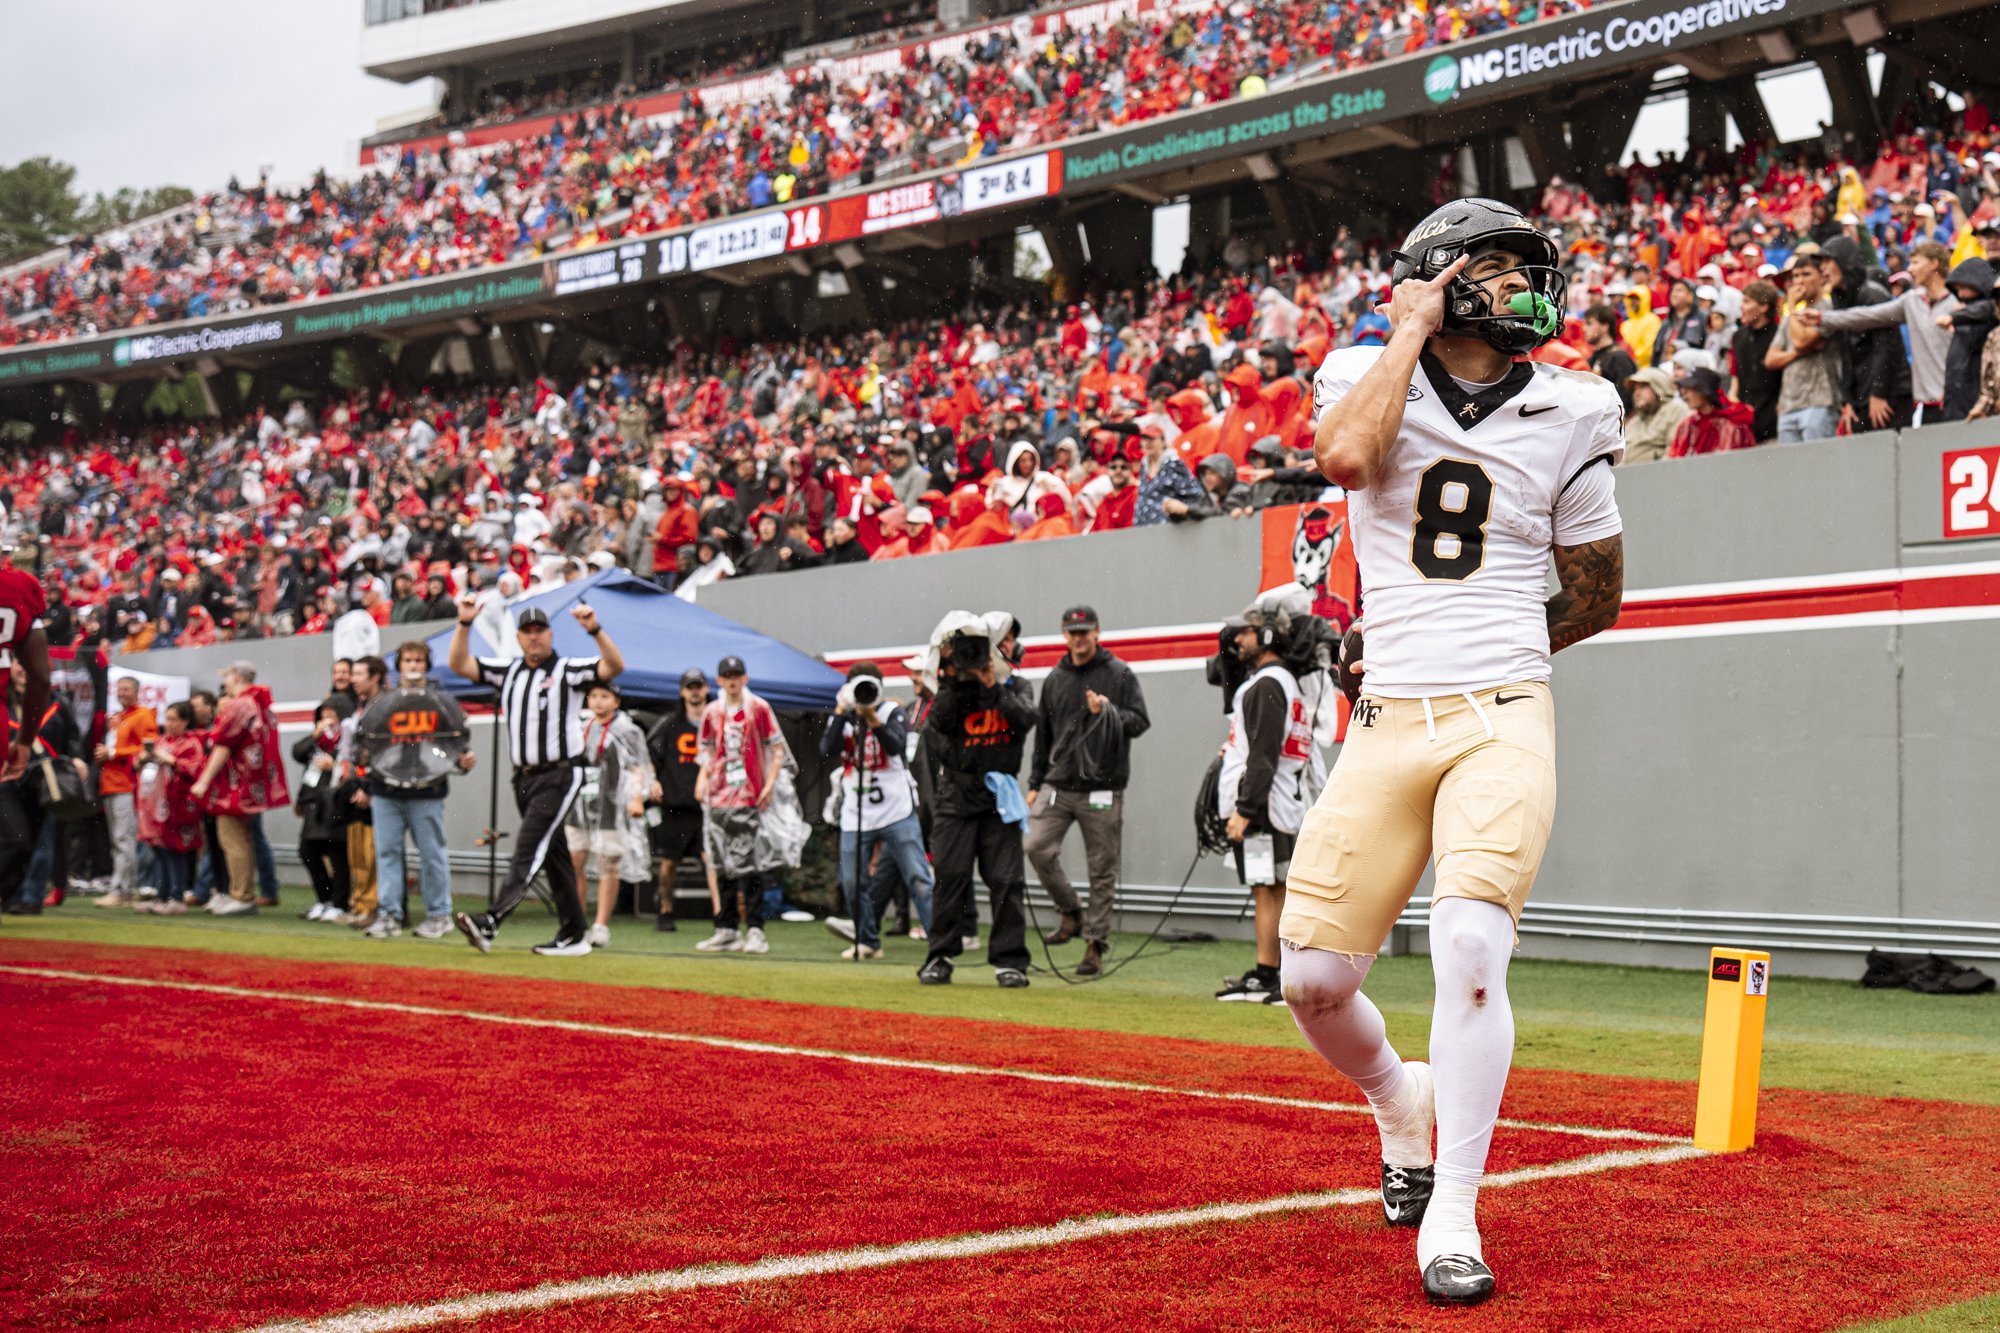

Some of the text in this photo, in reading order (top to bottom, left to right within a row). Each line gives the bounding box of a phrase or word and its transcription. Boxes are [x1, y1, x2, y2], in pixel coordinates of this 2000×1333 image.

[1067, 88, 1386, 181] North Carolinians across the State
[1022, 166, 1031, 188] 4
[790, 206, 821, 247] 14
[658, 236, 687, 274] 10
[1409, 455, 1496, 583] 8
[1354, 700, 1382, 727] WF
[1713, 964, 1739, 975] ACC
